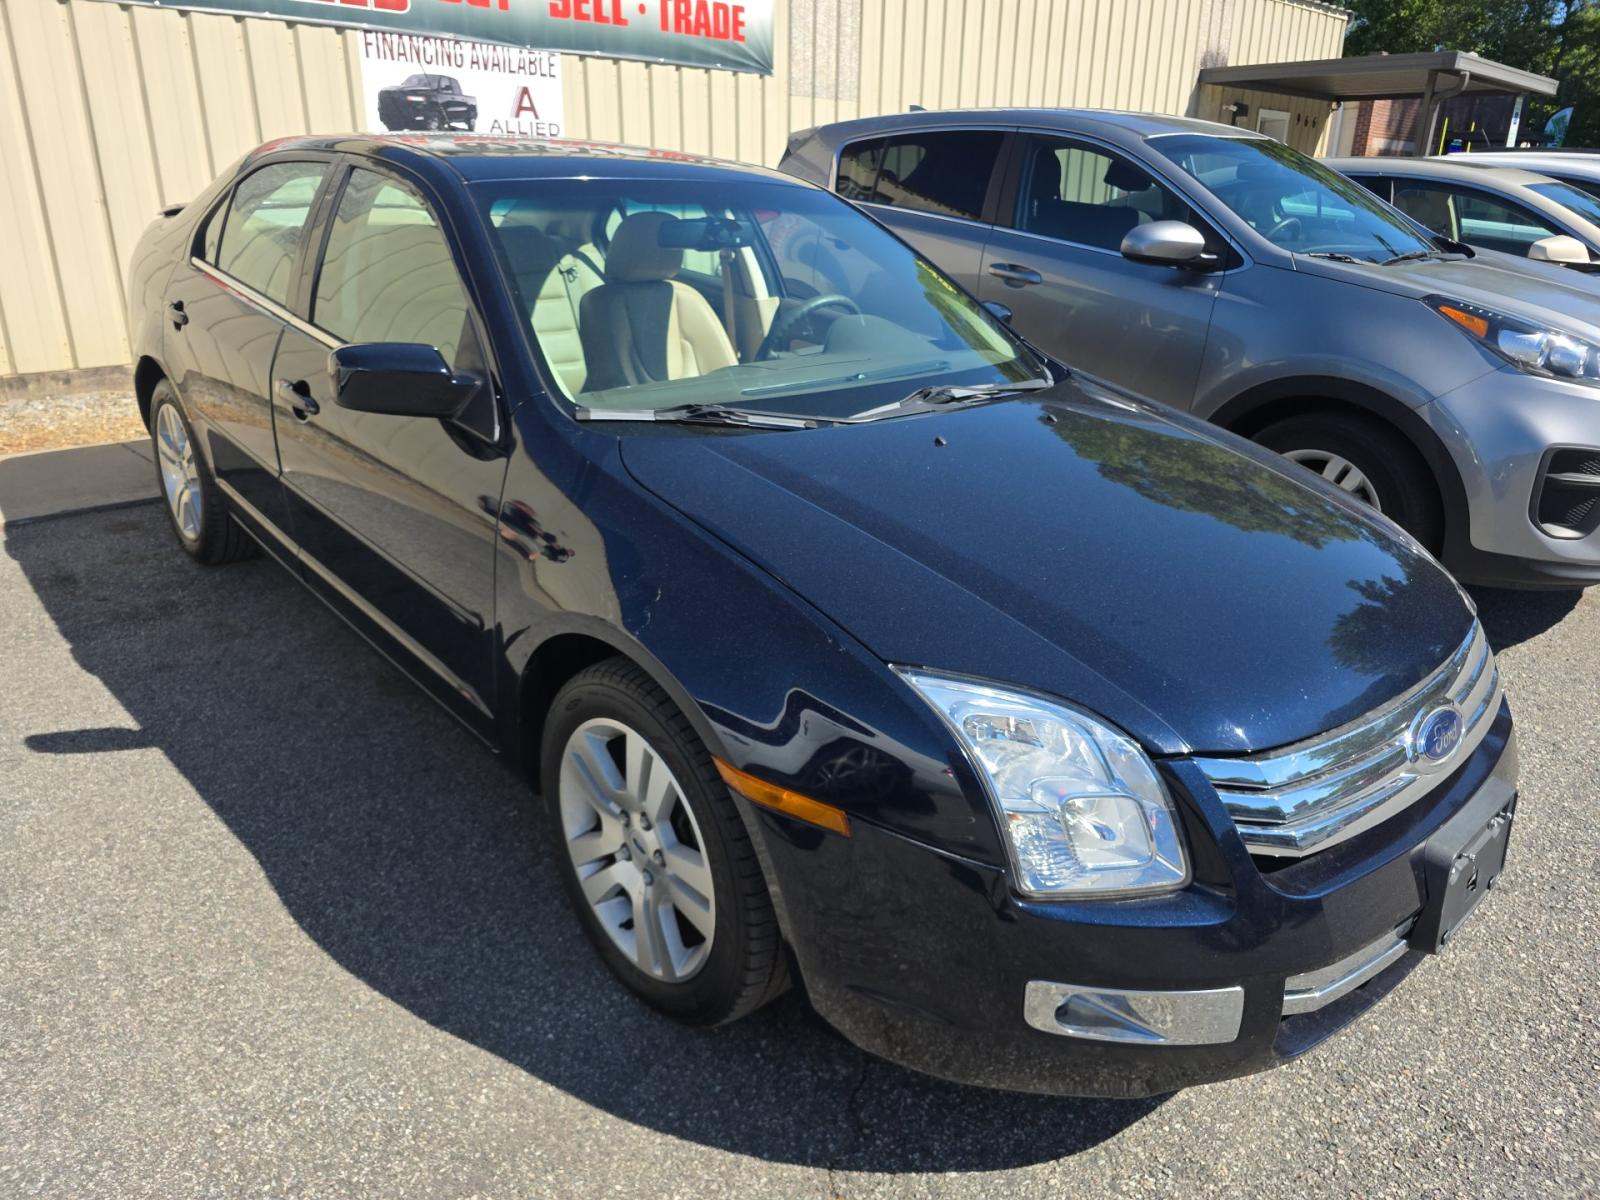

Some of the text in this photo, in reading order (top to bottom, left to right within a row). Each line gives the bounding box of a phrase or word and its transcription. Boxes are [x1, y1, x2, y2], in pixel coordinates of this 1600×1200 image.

[547, 0, 746, 42] SELL TRADE
[363, 31, 556, 78] FINANCING AVAILABLE
[489, 119, 561, 137] ALLIED
[1433, 719, 1457, 753] Ford
